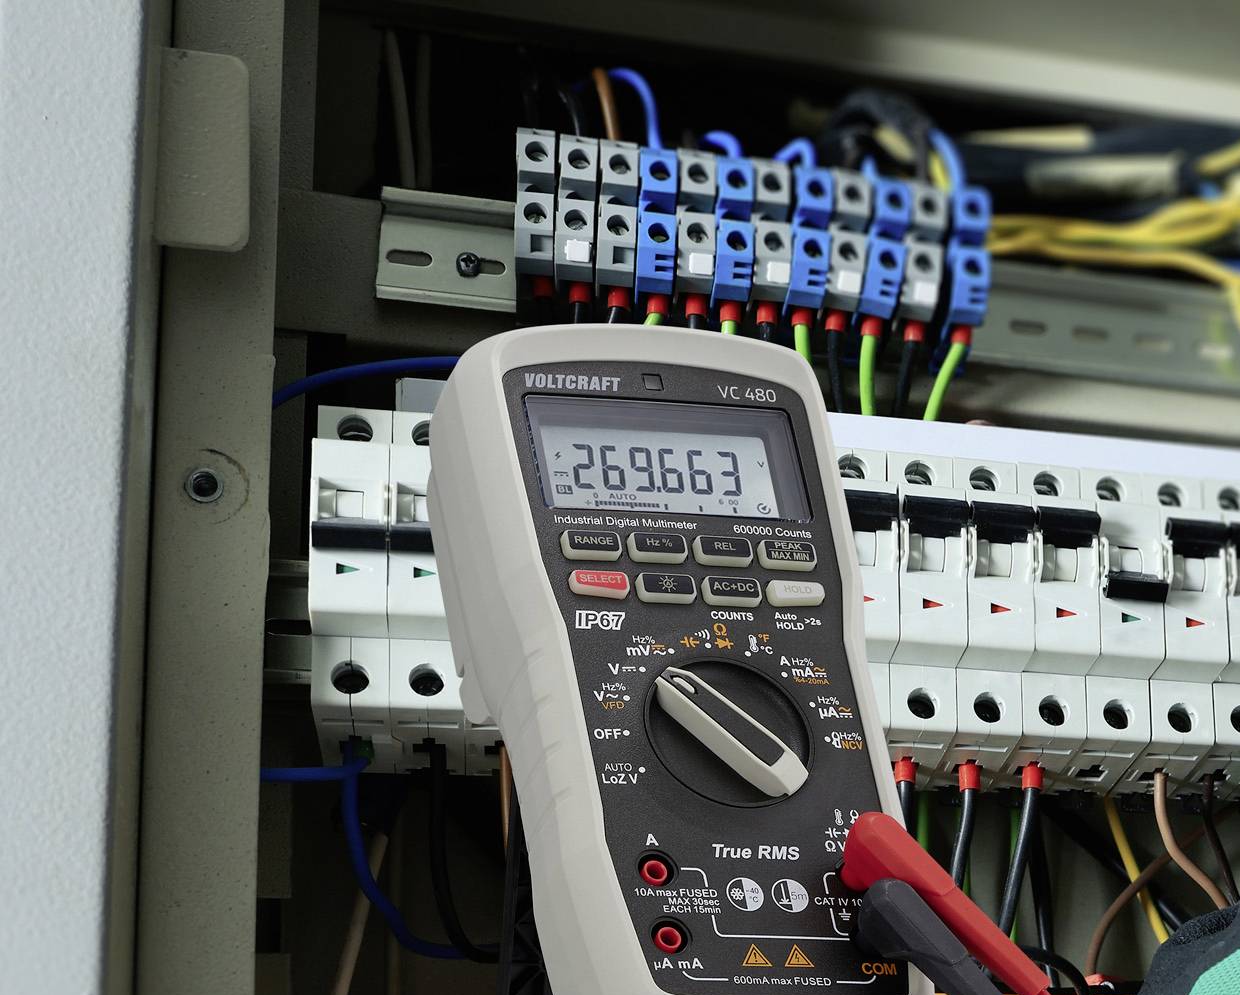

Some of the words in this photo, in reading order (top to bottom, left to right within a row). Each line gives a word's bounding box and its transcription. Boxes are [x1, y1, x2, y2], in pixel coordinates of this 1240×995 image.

[524, 373, 620, 392] VOLTCRAFT
[717, 385, 739, 400] VC
[745, 388, 777, 403] 480
[572, 443, 742, 496] 269.663
[609, 493, 637, 501] AUTO
[554, 515, 603, 525] Industrial
[606, 516, 640, 528] Digital
[642, 518, 697, 530] Multimeter
[733, 524, 772, 536] 600000
[775, 527, 812, 539] Counts
[574, 535, 614, 546] RANGE
[646, 538, 660, 547] Hz
[714, 541, 736, 551] REL
[774, 542, 802, 550] PEAK
[771, 551, 792, 560] MAX
[793, 552, 810, 561] MIN
[579, 573, 622, 584] SELECT
[713, 581, 755, 592] AC+DC
[784, 584, 812, 594] HOLD
[575, 610, 626, 631] IP67
[710, 610, 754, 621] COUNTS
[774, 611, 797, 620] Auto
[776, 621, 805, 631] HOLD
[626, 645, 651, 656] mV
[780, 655, 791, 667] A
[601, 701, 625, 710] VFD
[593, 728, 622, 740] OFF
[841, 740, 863, 750] NCV
[604, 762, 633, 772] AUTO
[601, 773, 627, 784] LoZ
[628, 773, 638, 784] V
[645, 833, 659, 846] A
[712, 844, 752, 859] True
[758, 845, 800, 860] RMS
[634, 888, 656, 897] 10A
[656, 889, 678, 897] max
[679, 888, 718, 898] FUSED
[791, 892, 808, 901] 5m
[668, 897, 691, 906] MAX
[692, 897, 720, 906] 30sec
[814, 896, 835, 906] CAT
[838, 897, 849, 907] IV
[663, 904, 691, 914] EACH
[694, 905, 722, 914] 15min
[677, 957, 704, 970] mA
[861, 962, 897, 976] COM
[733, 975, 770, 985] 600mA
[771, 977, 792, 986] max
[794, 976, 831, 986] FUSED
